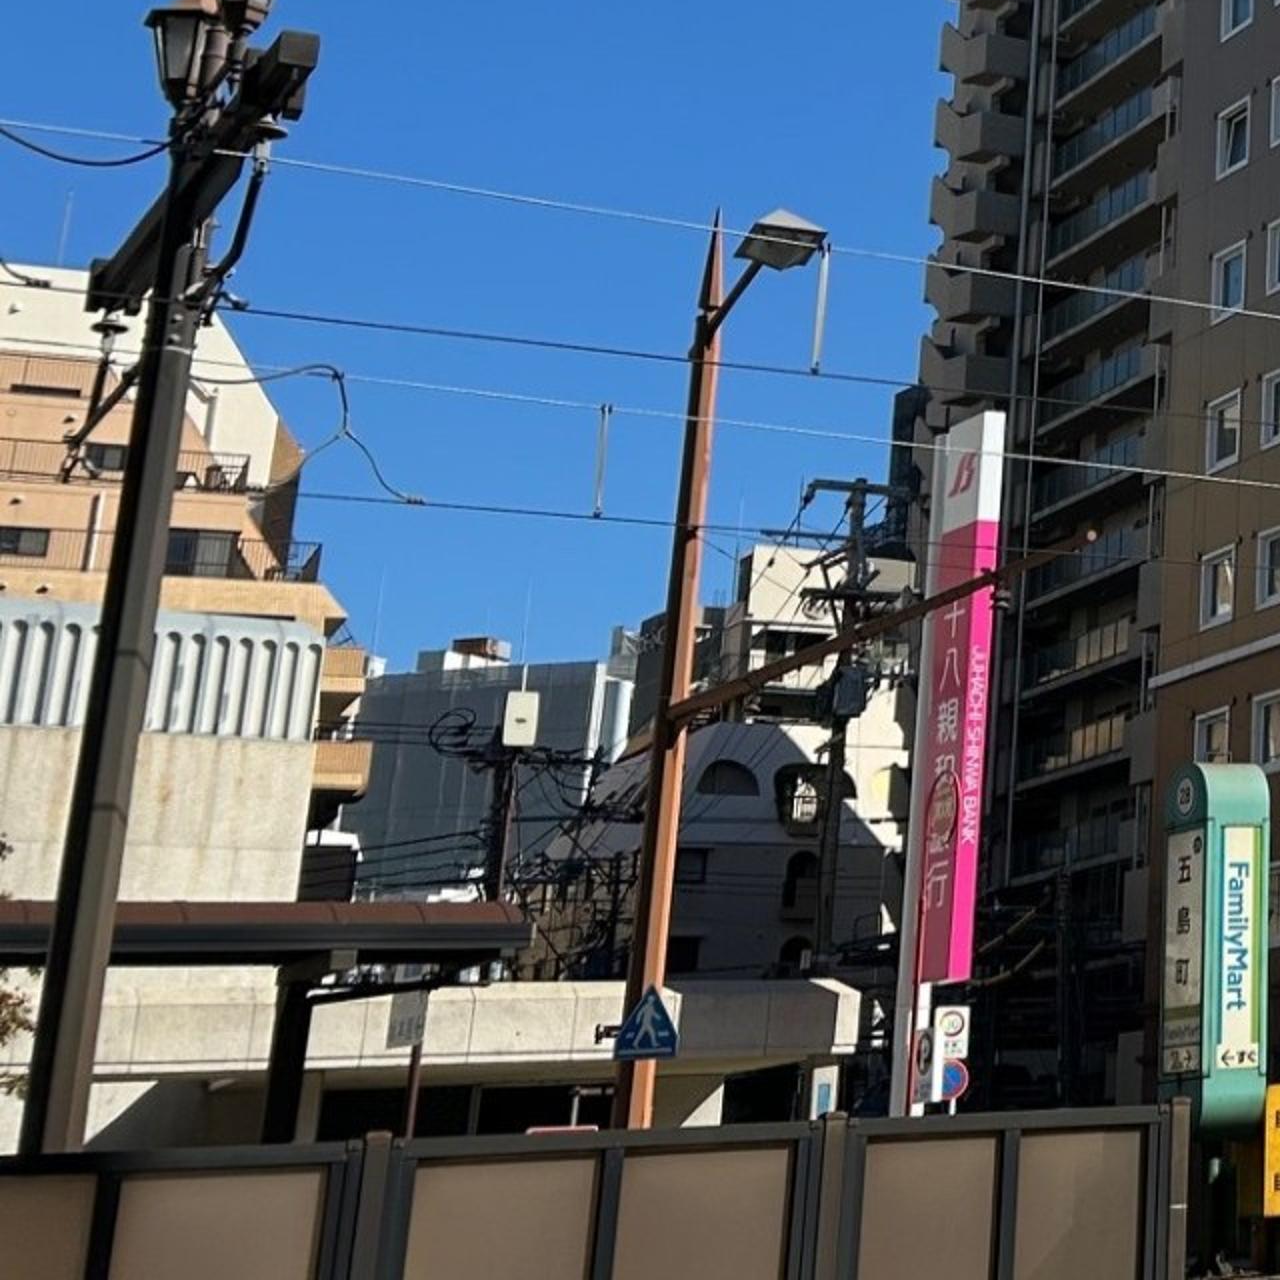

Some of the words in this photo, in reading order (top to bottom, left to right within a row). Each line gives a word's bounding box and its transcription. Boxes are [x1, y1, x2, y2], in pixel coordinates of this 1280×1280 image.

[961, 797, 978, 845] BANK
[1176, 855, 1192, 985] 五島町
[1223, 861, 1249, 1011] FamilyMart
